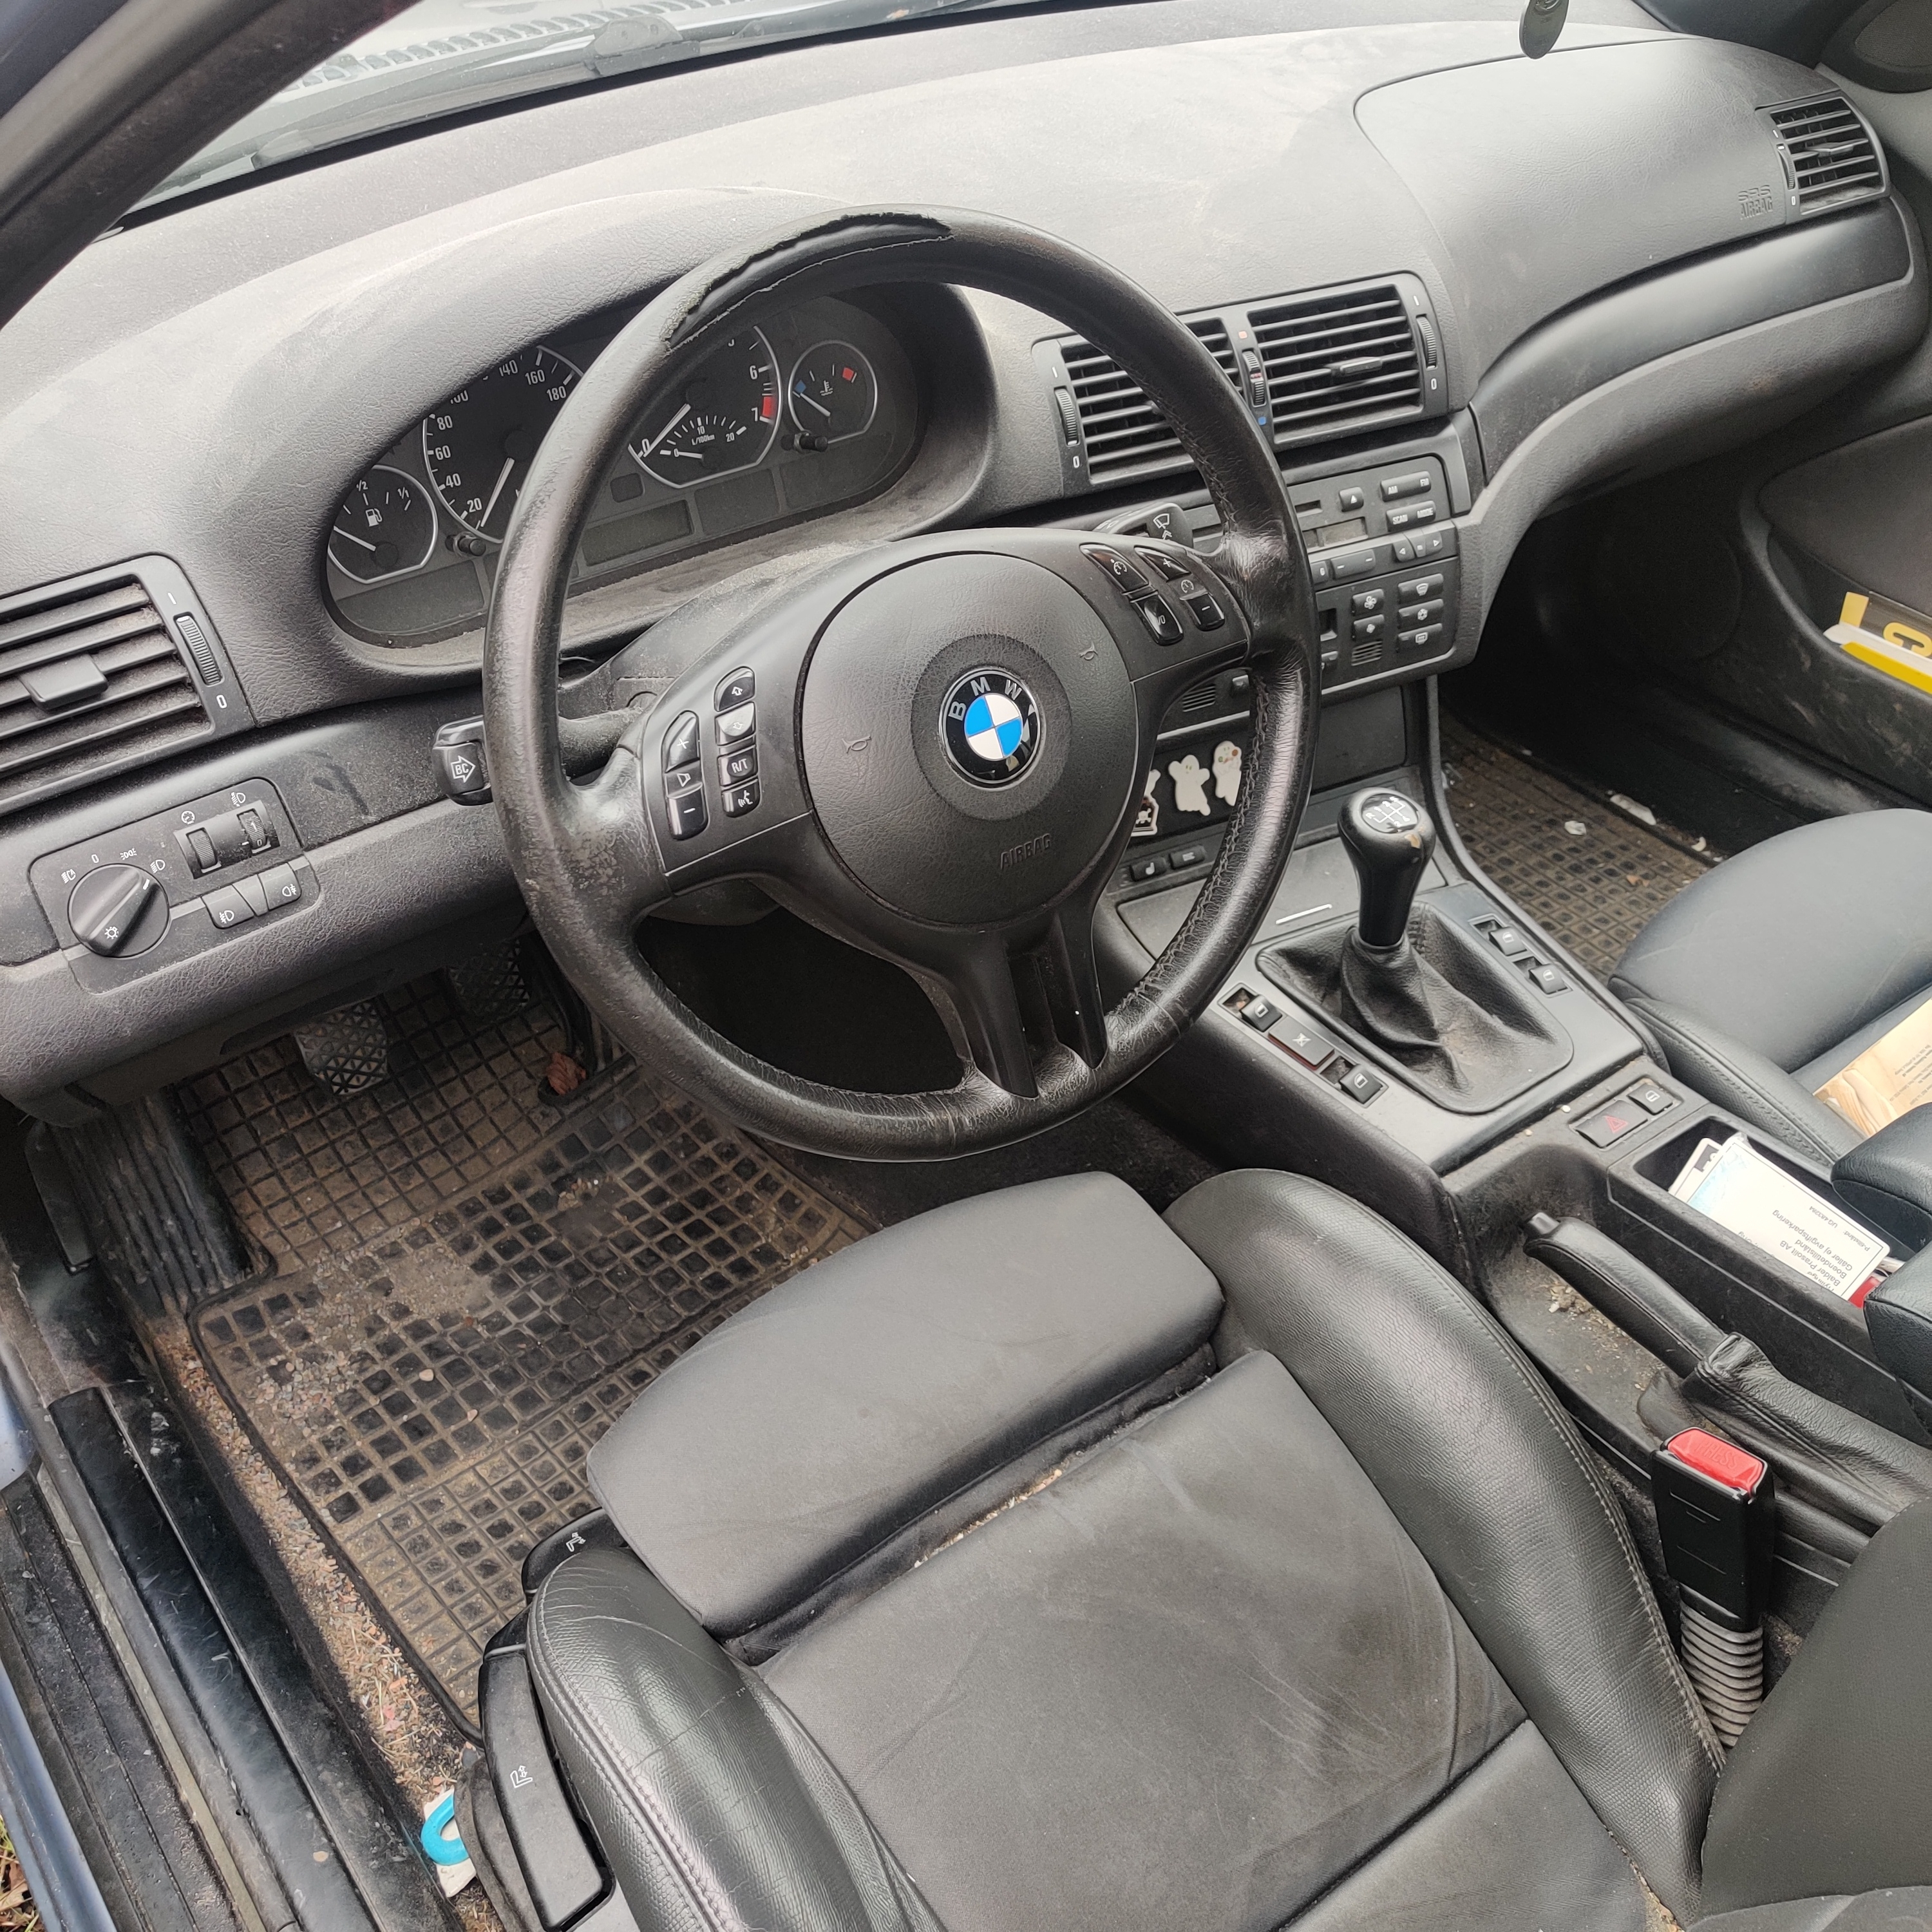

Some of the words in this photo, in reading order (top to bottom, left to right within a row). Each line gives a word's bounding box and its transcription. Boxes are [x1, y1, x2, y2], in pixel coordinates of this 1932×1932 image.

[1740, 196, 1774, 220] AIRBAG
[525, 369, 545, 386] 160
[749, 365, 759, 380] 6
[547, 386, 567, 402] 180
[751, 407, 759, 422] 7
[437, 415, 453, 431] 80
[697, 426, 705, 435] 10
[726, 432, 735, 442] 20
[435, 445, 451, 461] 60
[446, 473, 462, 489] 40
[467, 497, 482, 513] 20
[948, 676, 1022, 721] BMW
[455, 762, 469, 775] BC
[731, 758, 748, 773] R/T
[1000, 833, 1050, 869] AIRBAG
[1772, 1209, 1824, 1249] avgiftsparkering
[1828, 1219, 1838, 1228] UG
[1779, 1240, 1793, 1251] AB
[1823, 1247, 1832, 1255] ej
[1791, 1248, 1817, 1270] Prasolit
[1795, 1239, 1847, 1279] Boendetillstånd
[1817, 1267, 1841, 1287] Balder
[1694, 1439, 1739, 1470] PRESS
